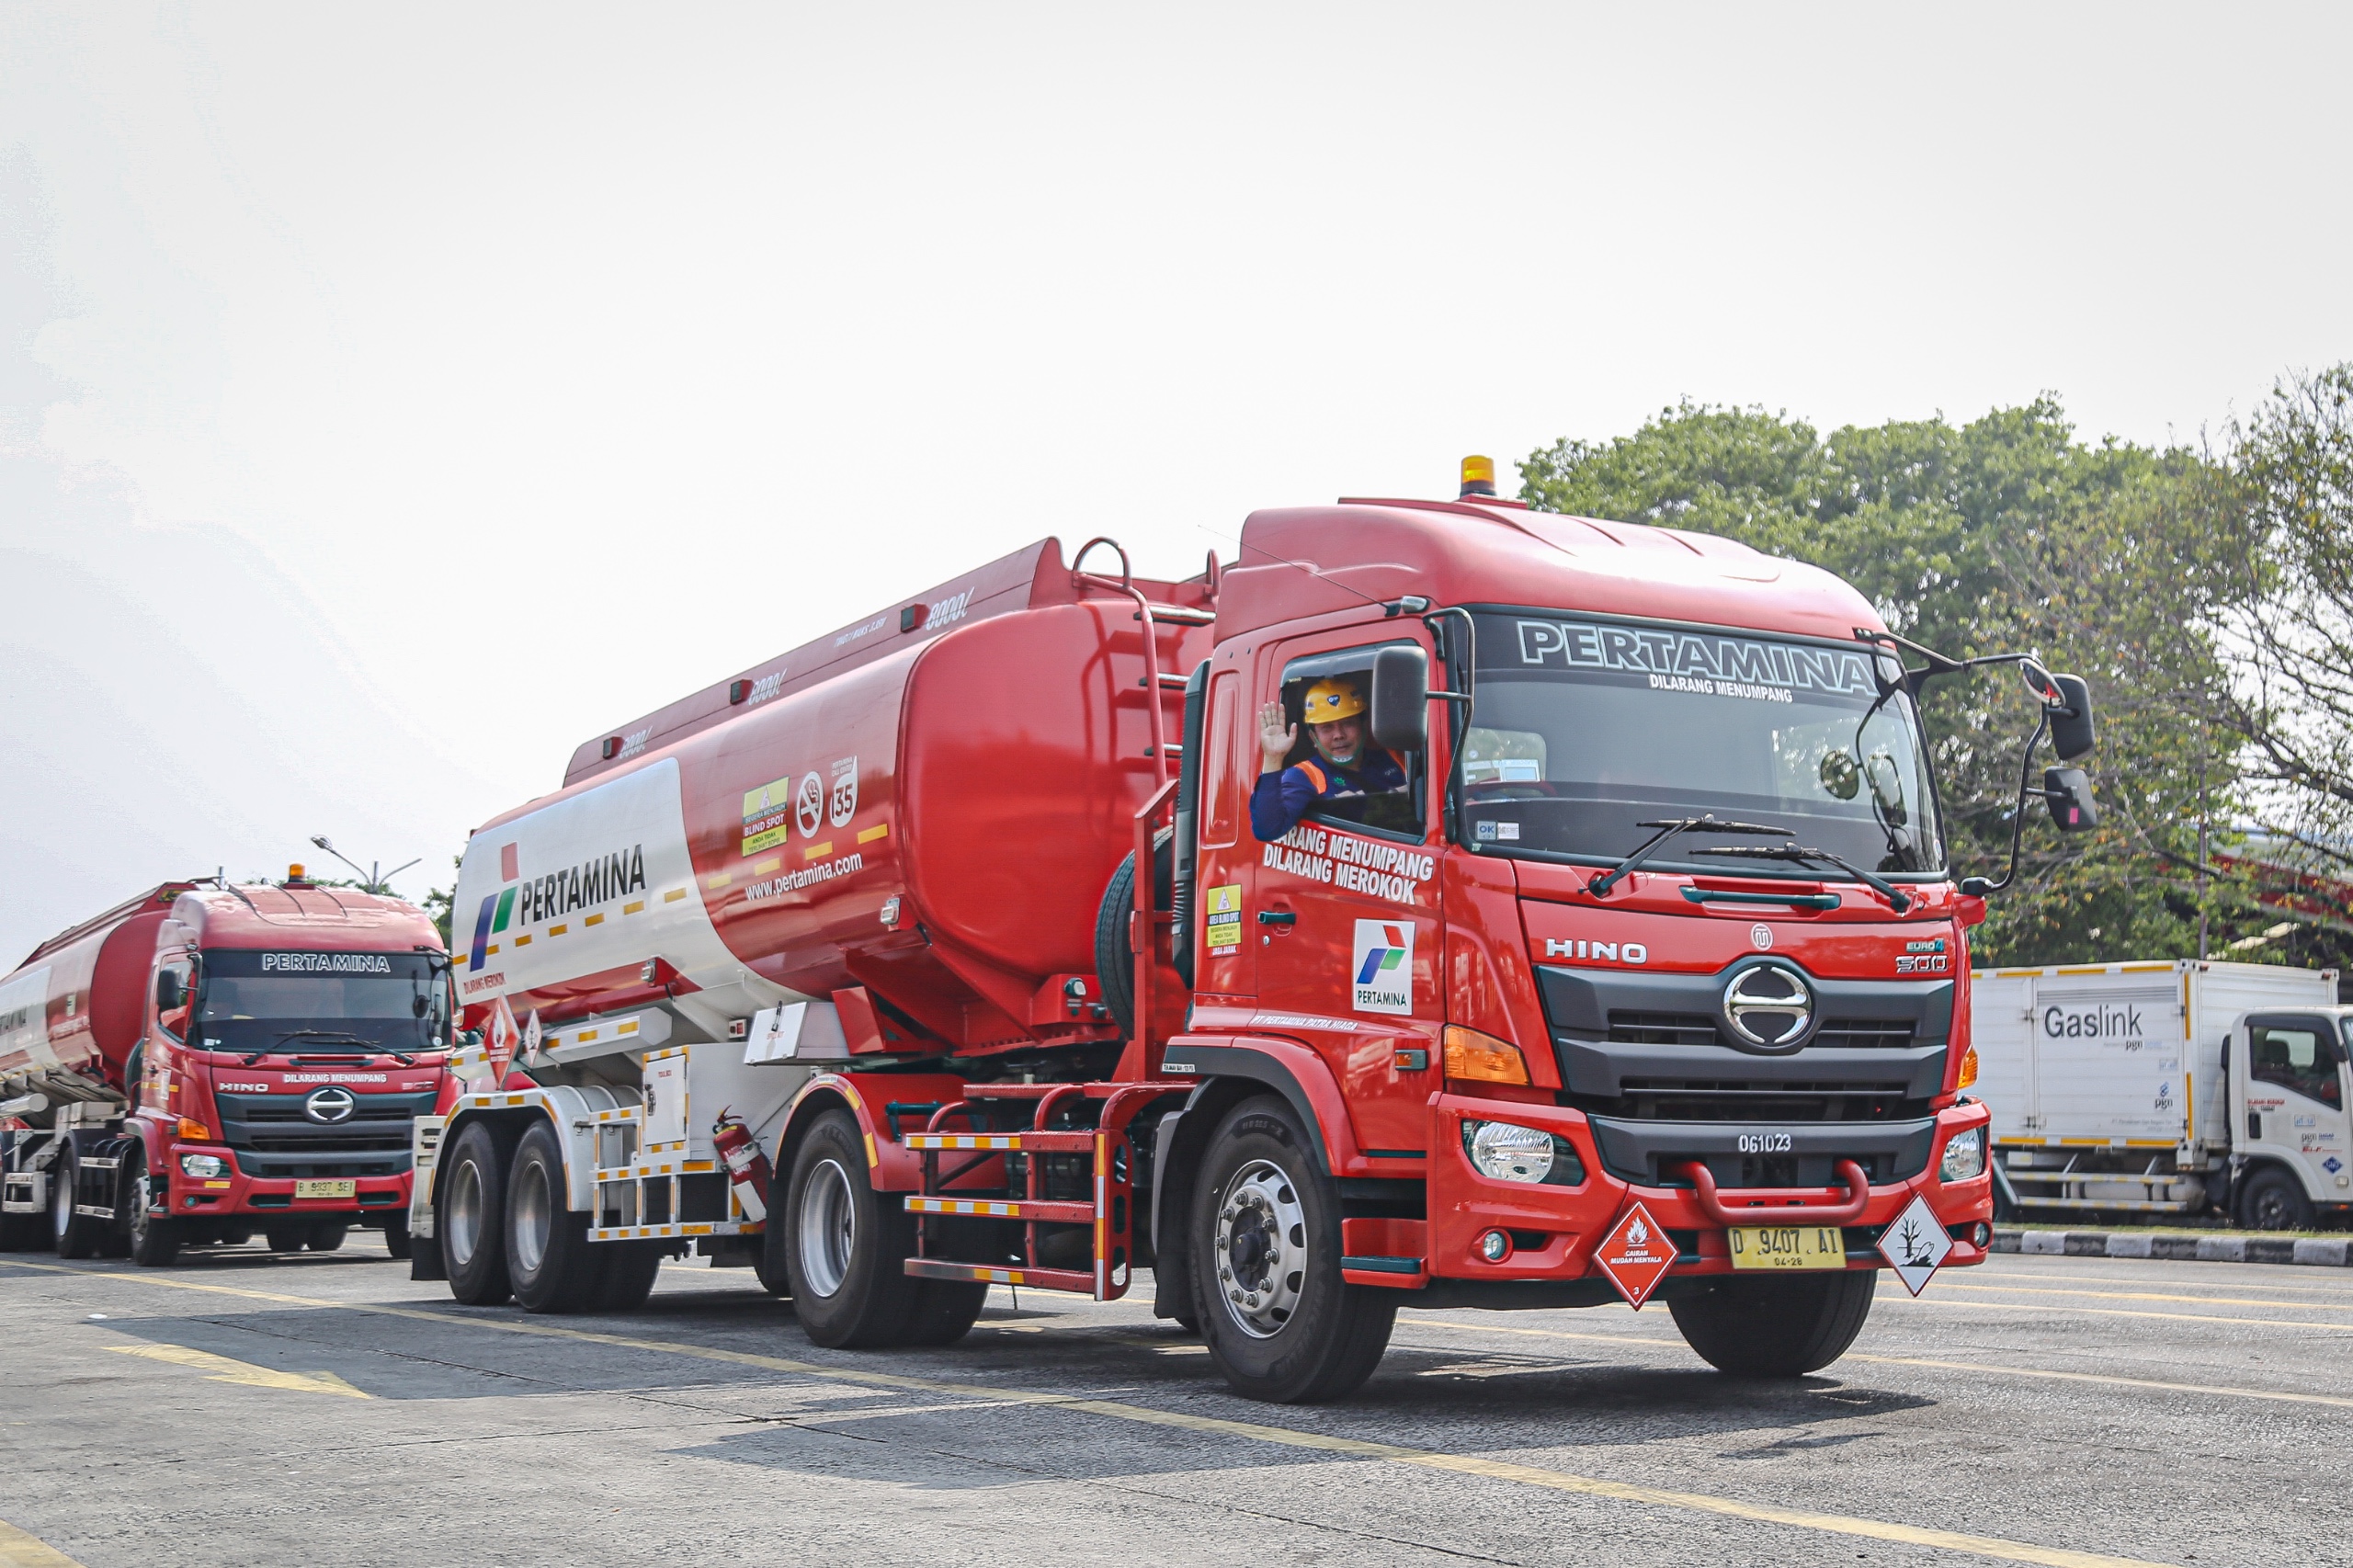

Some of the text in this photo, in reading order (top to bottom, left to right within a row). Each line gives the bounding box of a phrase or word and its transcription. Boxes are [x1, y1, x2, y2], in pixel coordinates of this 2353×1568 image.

[1517, 620, 1881, 698] PERTAMINA
[1650, 673, 1793, 703] DILARANG MENUMPANG
[745, 813, 785, 837] BLIND SPOT
[1479, 825, 1495, 834] OK
[1329, 834, 1435, 881] MENUMPANG
[745, 852, 863, 902] www.pertamina.com
[1263, 844, 1417, 905] DILARANG MEROKOK
[520, 844, 647, 926] PERTAMINA
[1546, 938, 1647, 964] HINO
[262, 953, 391, 972] PERTAMINA
[1895, 955, 1948, 973] 500
[1358, 990, 1407, 1006] PERTAMINA
[1251, 1015, 1358, 1031] PT PERTAMINA PATRA NIAGA
[2044, 1003, 2143, 1039] Gaslink
[2126, 1040, 2143, 1051] pgn
[219, 1083, 269, 1092] HINO
[283, 1074, 387, 1083] DILARANG MENUMPANG
[2154, 1098, 2173, 1109] pgn
[1738, 1132, 1791, 1153] 061023
[299, 1182, 304, 1192] B
[1733, 1229, 1745, 1254] D
[1818, 1229, 1838, 1253] AI
[1634, 1286, 1640, 1295] 3
